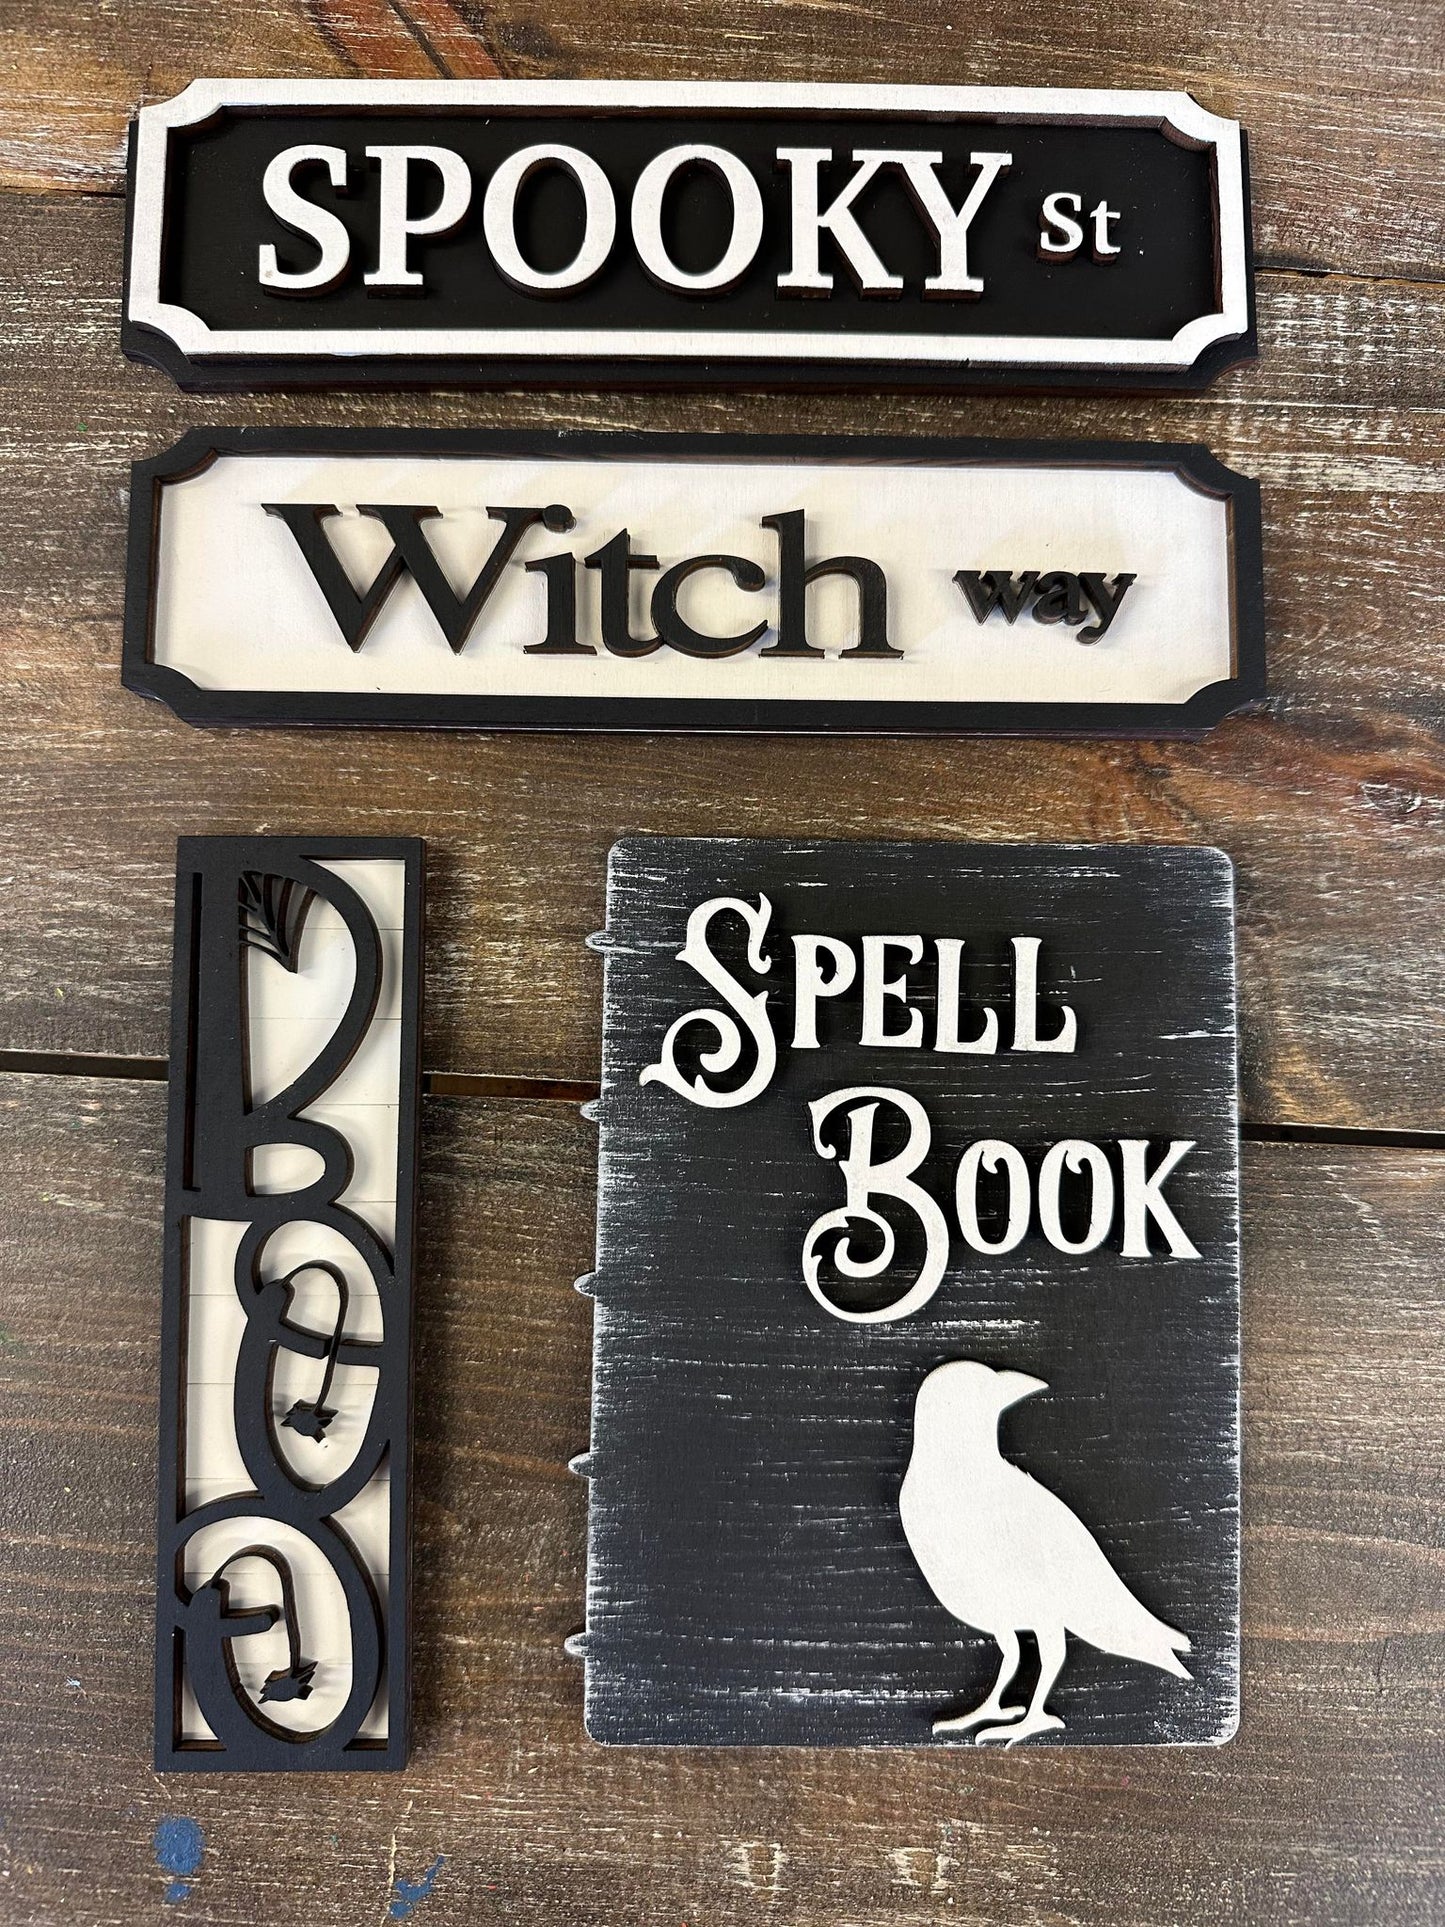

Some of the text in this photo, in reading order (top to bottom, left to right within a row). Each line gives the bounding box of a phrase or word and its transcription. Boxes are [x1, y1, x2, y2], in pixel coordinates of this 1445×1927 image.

[256, 142, 1122, 296] SPOOKY St
[261, 500, 1138, 661] Witch way
